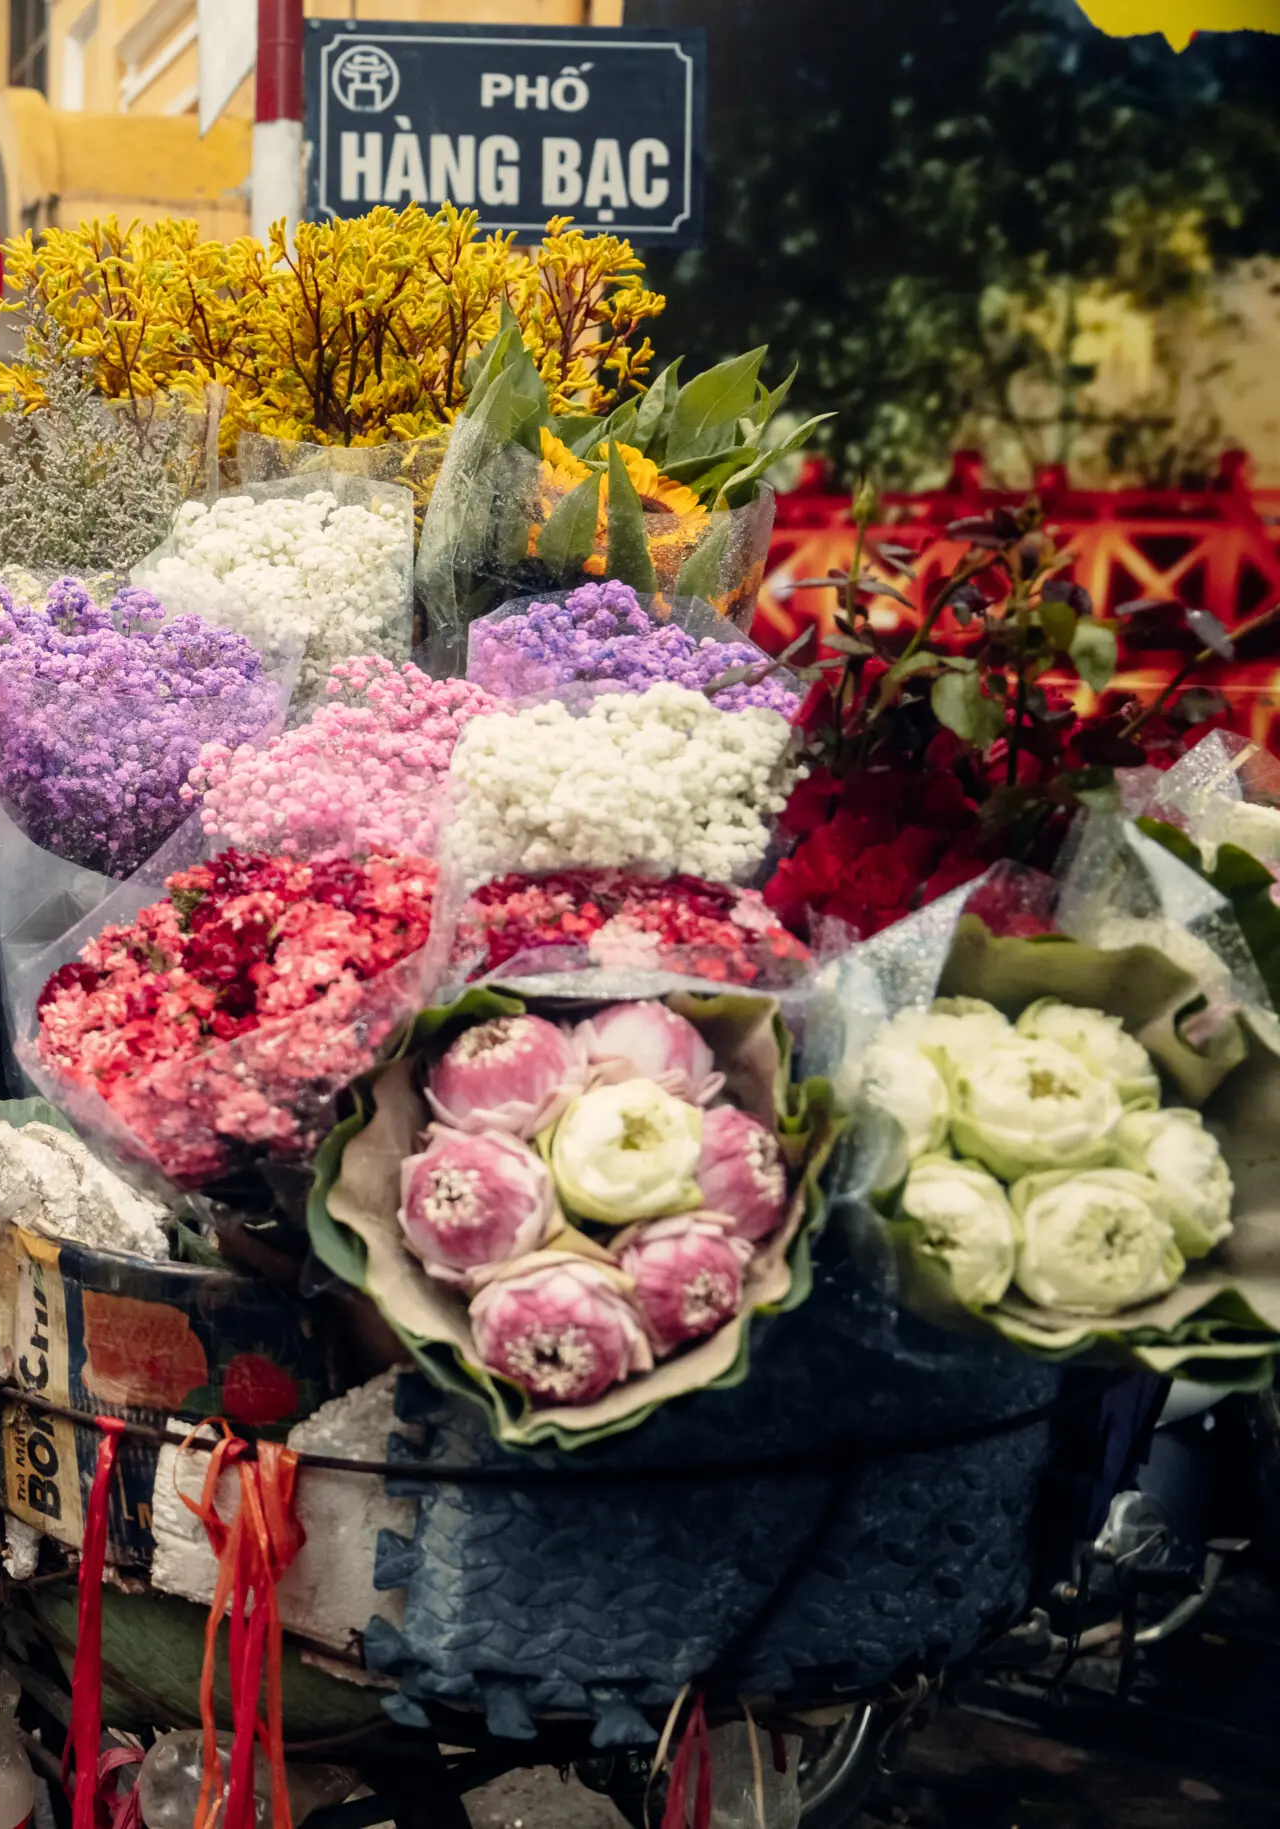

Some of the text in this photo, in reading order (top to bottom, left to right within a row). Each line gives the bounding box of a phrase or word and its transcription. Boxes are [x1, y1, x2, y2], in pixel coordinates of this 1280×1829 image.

[480, 62, 594, 112] PHỐ
[340, 116, 670, 222] HÀNG BẠC
